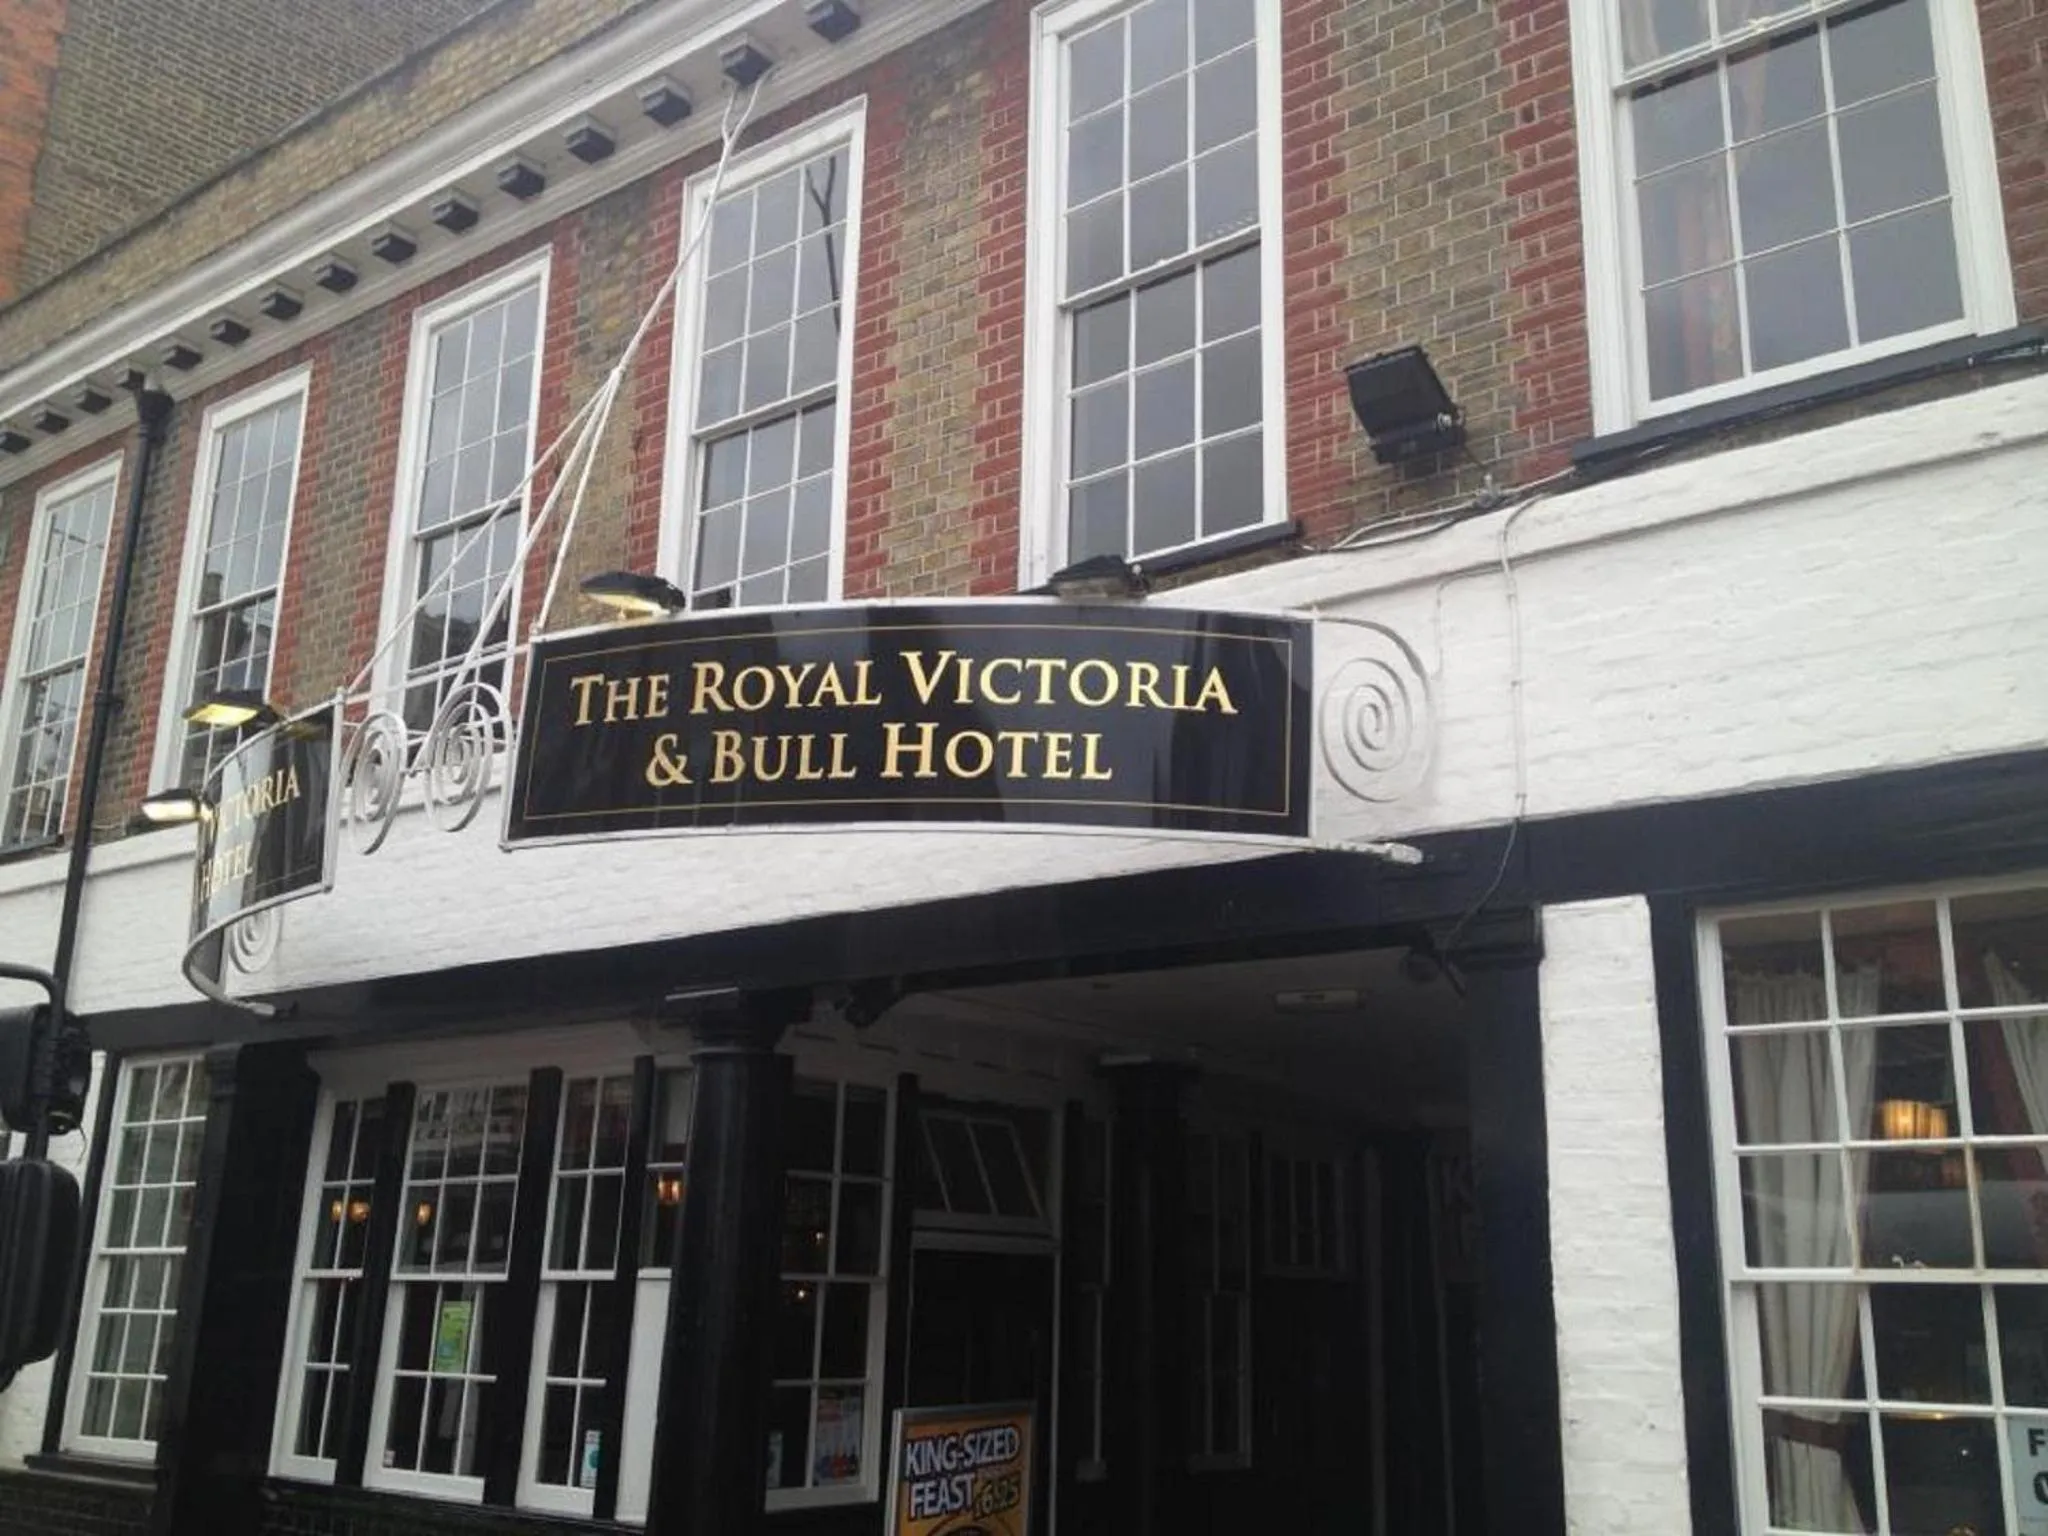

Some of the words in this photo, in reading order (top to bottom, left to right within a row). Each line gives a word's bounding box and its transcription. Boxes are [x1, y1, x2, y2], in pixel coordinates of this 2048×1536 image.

[570, 673, 670, 726] THE
[690, 660, 882, 715] ROYAL
[900, 650, 1239, 715] VICTORIA
[645, 733, 693, 787] &
[708, 730, 857, 784] BULL
[880, 722, 1113, 781] HOTEL
[906, 1426, 1021, 1477] KING-SIZED
[911, 1473, 976, 1518] FEAST
